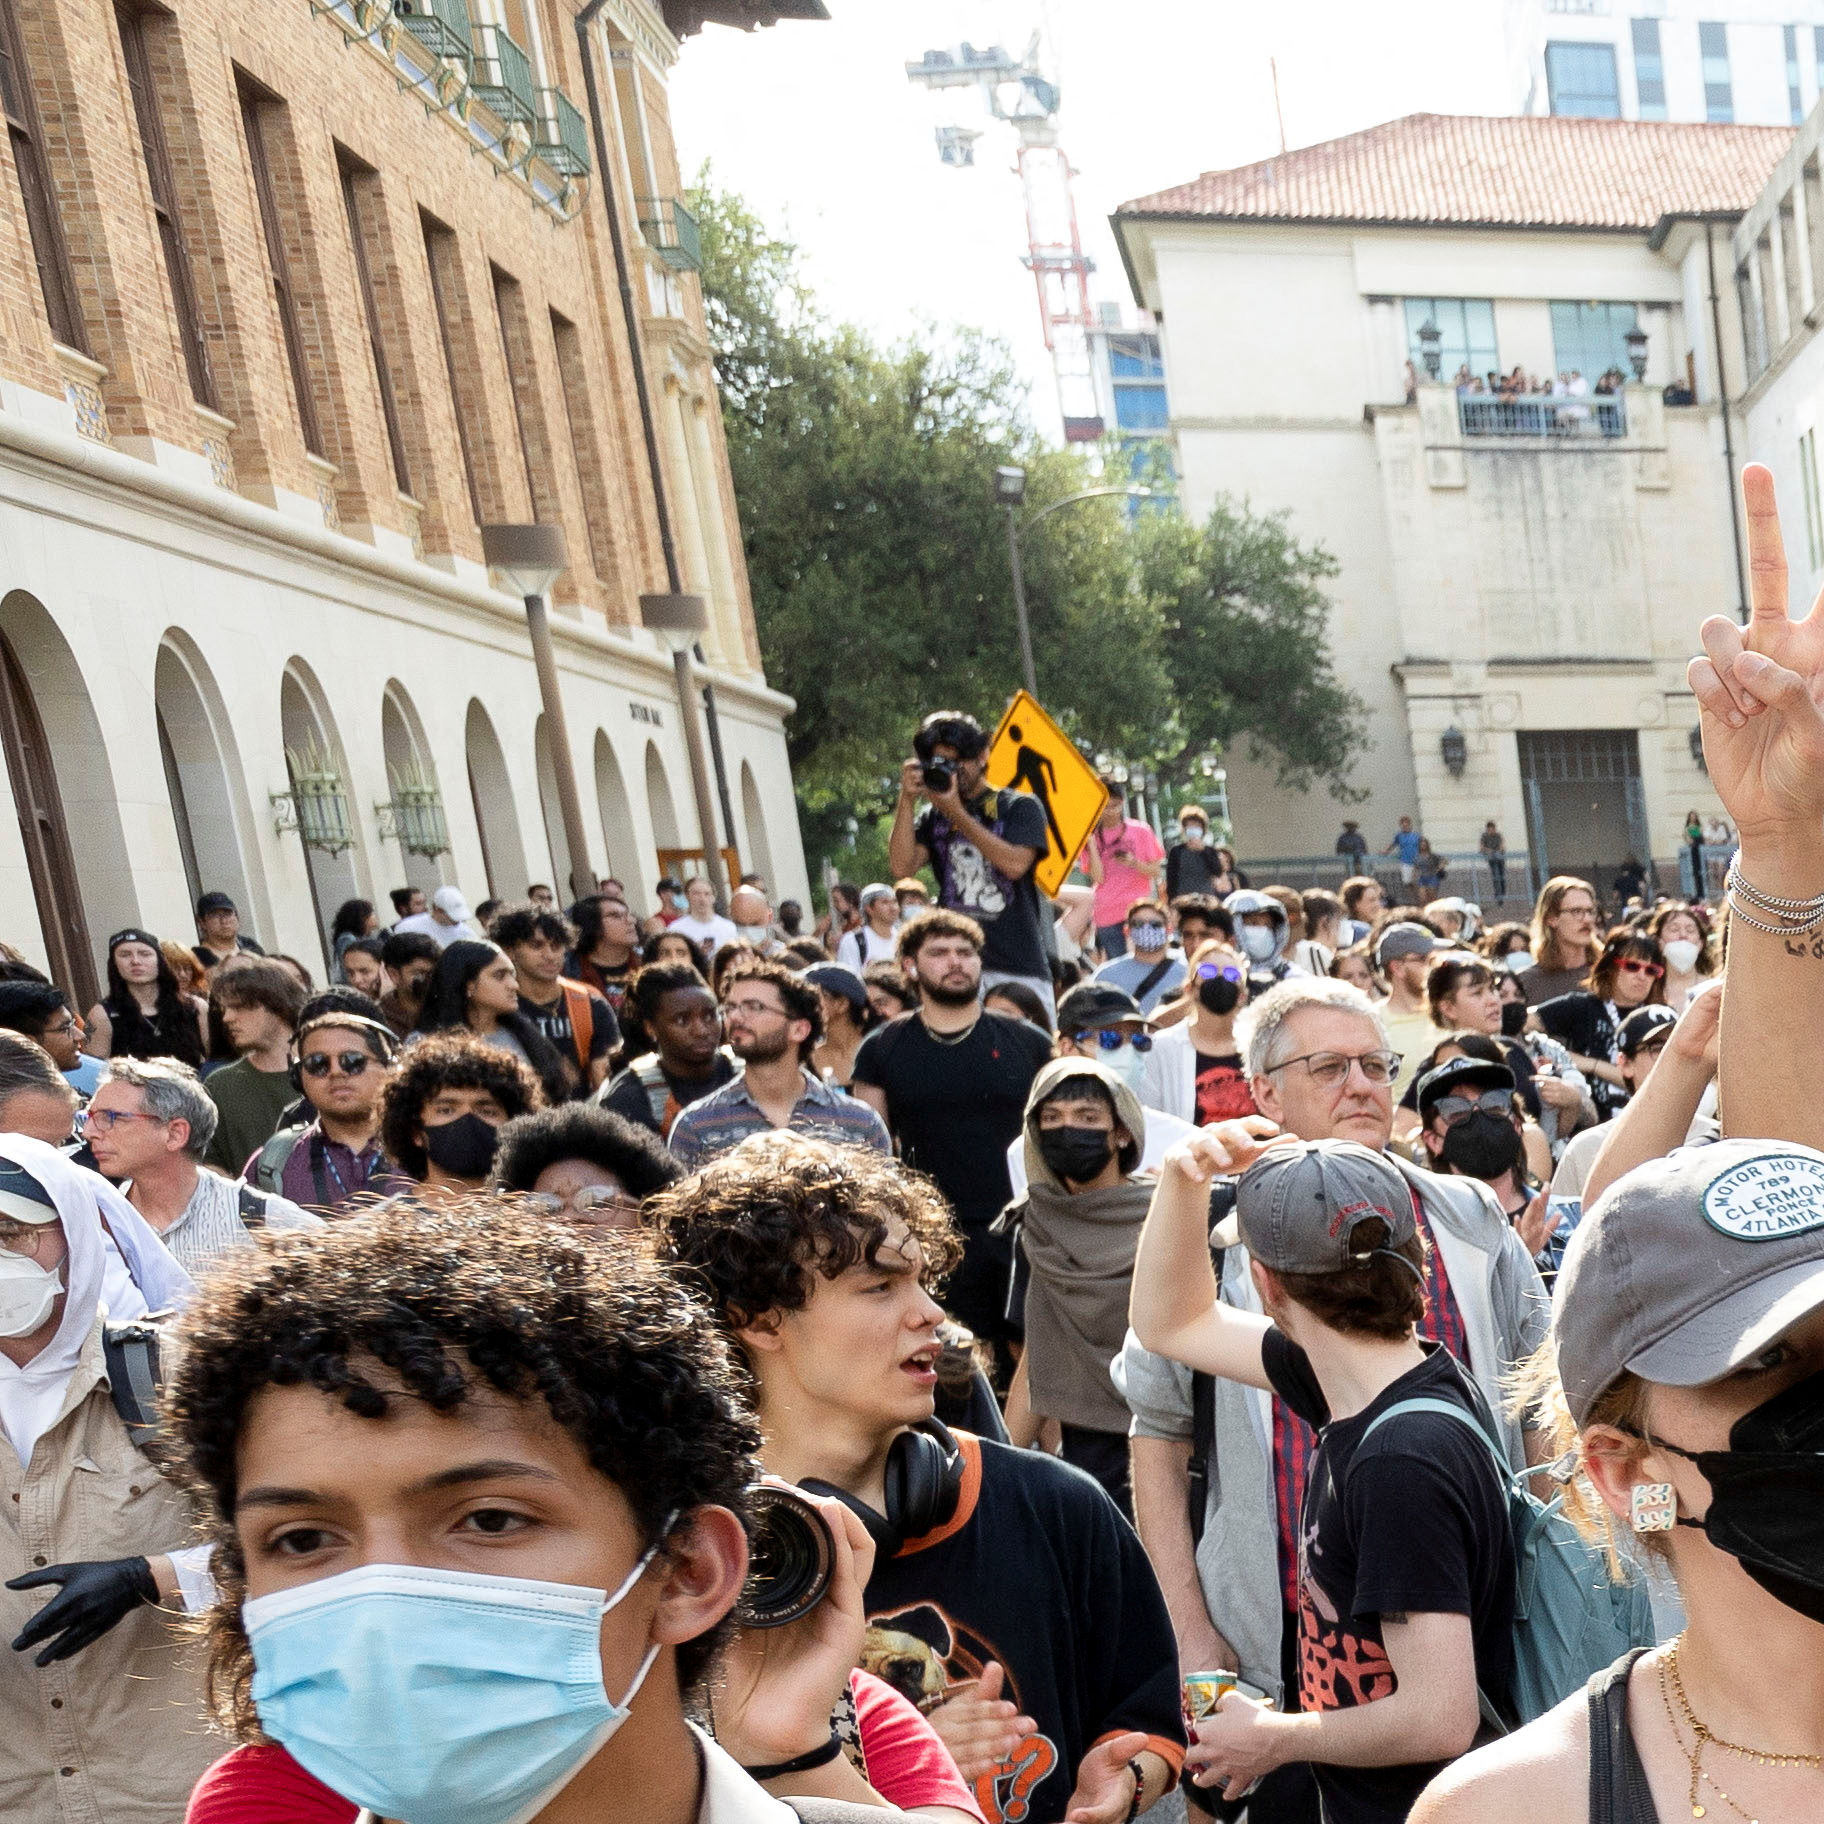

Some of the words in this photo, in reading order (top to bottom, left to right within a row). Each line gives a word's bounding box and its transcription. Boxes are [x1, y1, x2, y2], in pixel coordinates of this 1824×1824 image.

[1714, 1166, 1763, 1208] MOTOR
[1756, 1175, 1791, 1190] 789
[1766, 1197, 1819, 1217] PONCE
[1740, 1208, 1823, 1232] ATLANTA
